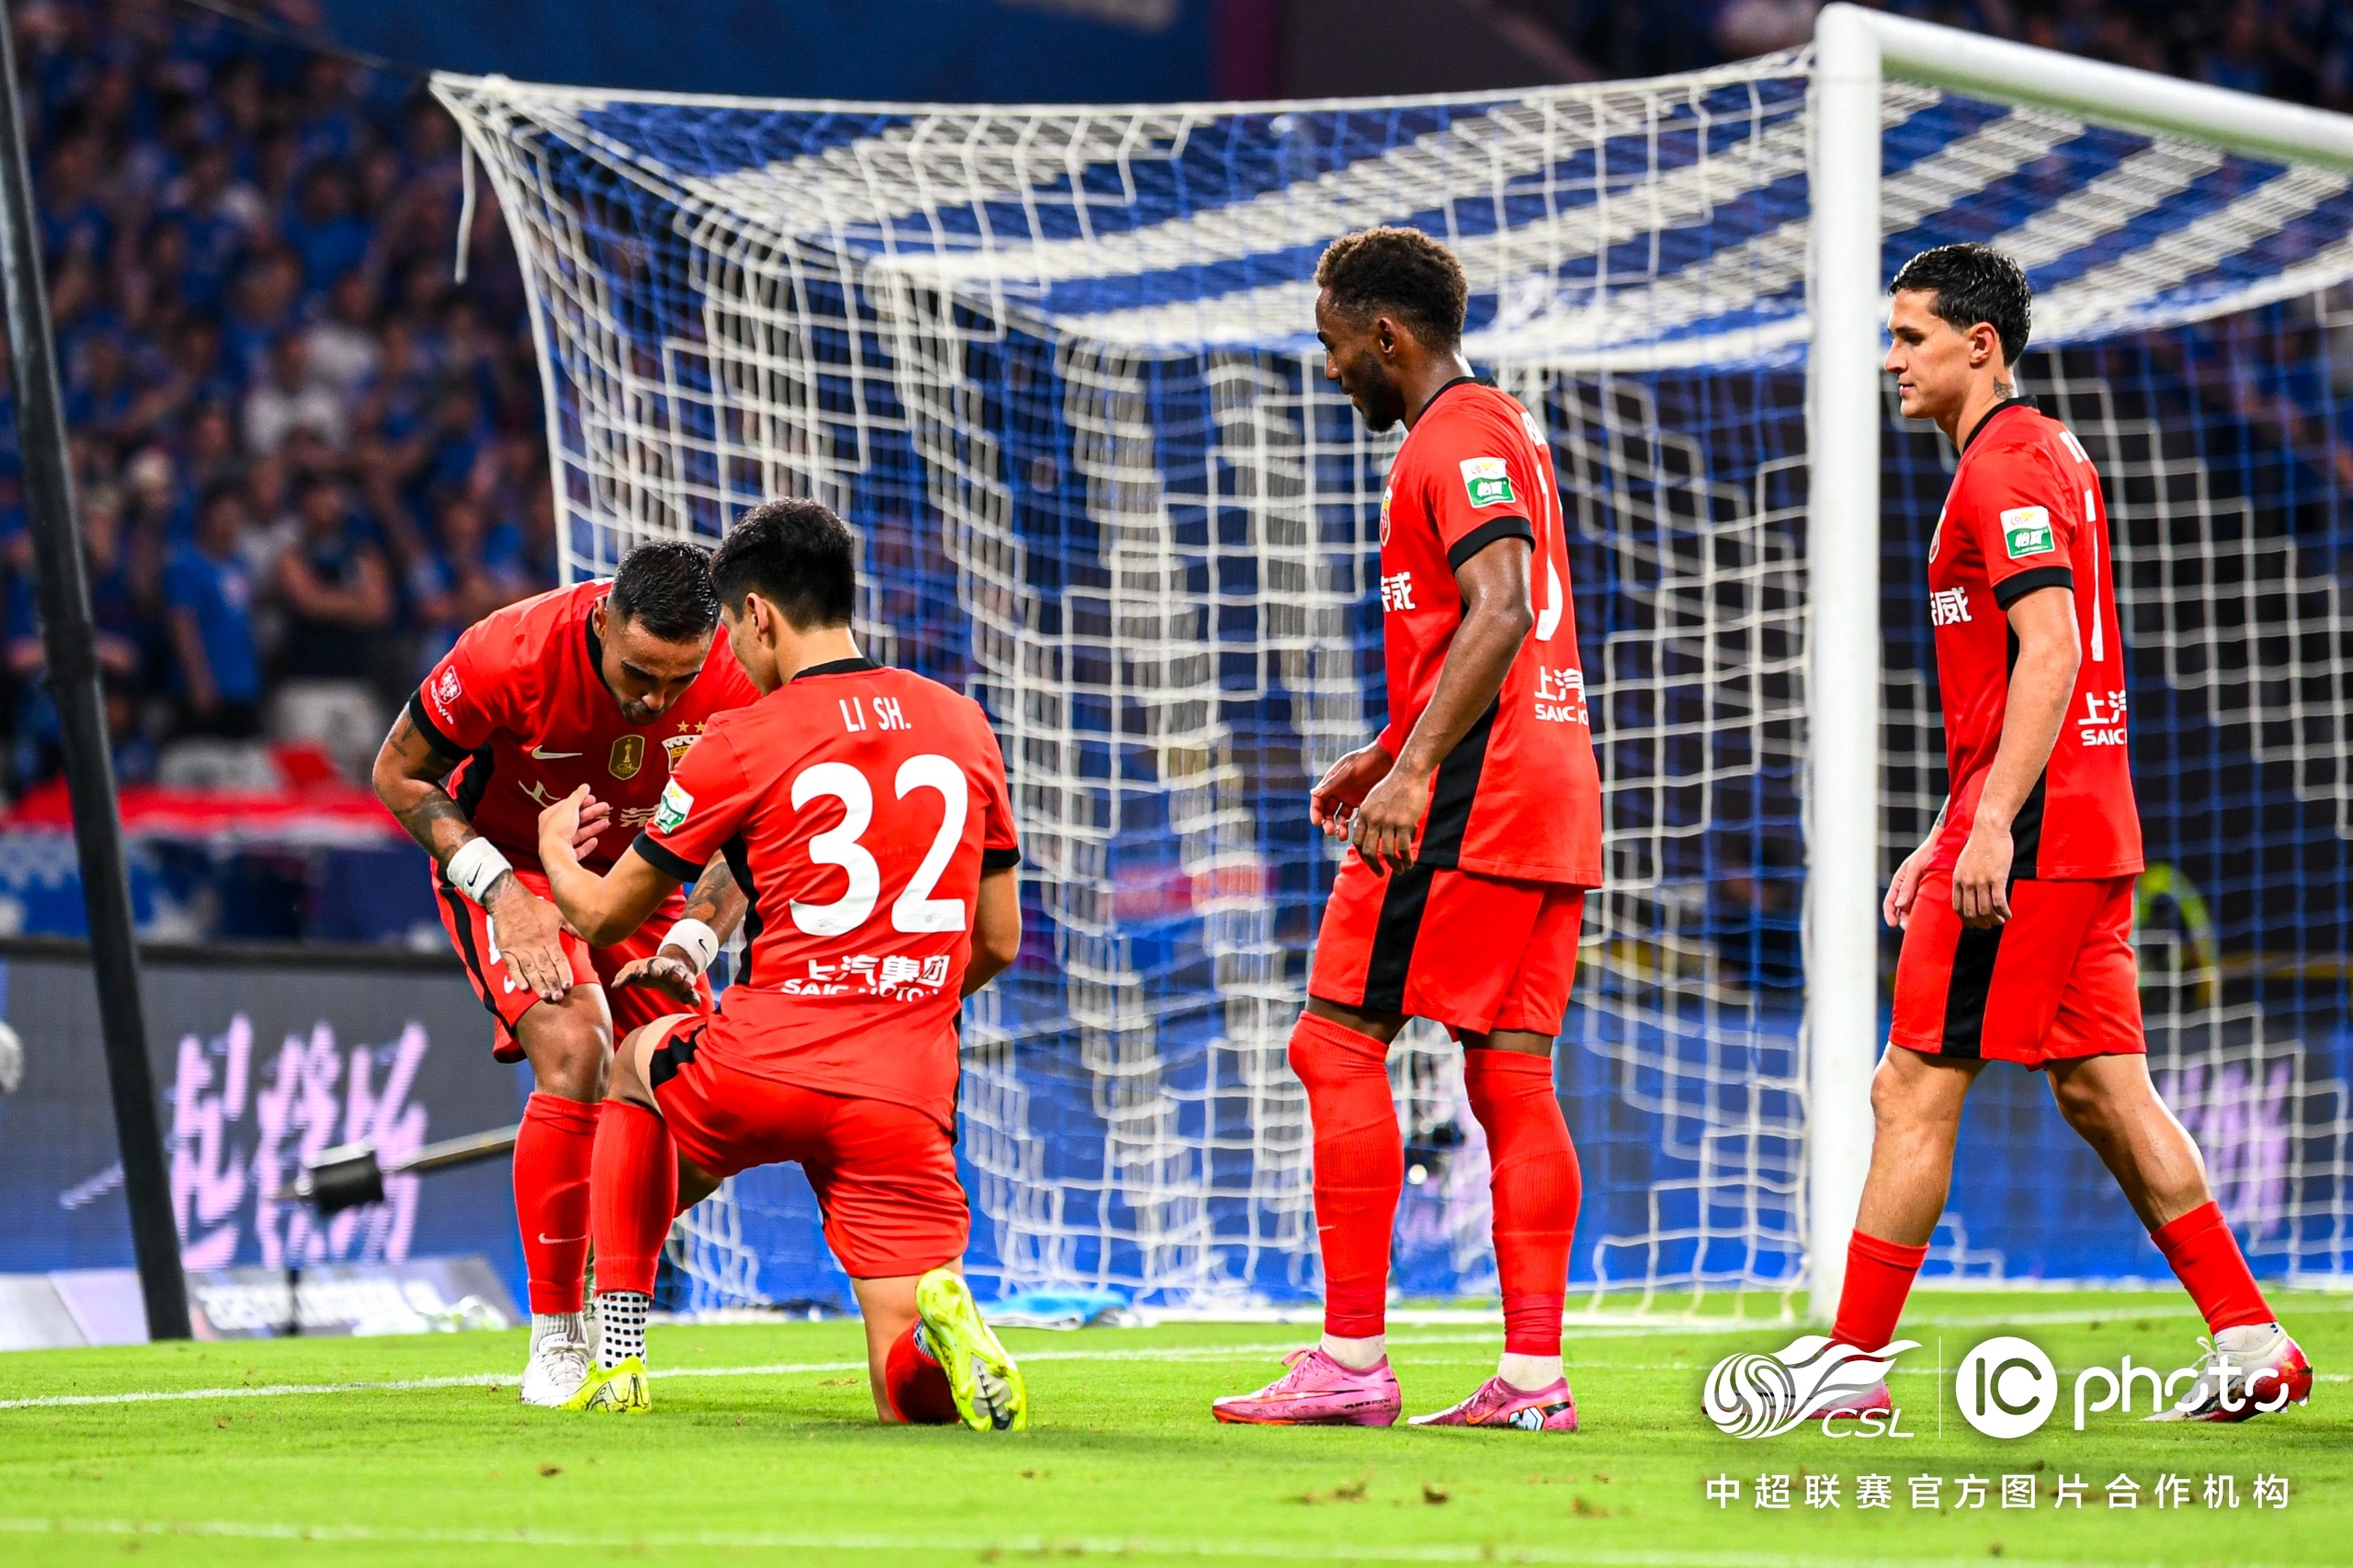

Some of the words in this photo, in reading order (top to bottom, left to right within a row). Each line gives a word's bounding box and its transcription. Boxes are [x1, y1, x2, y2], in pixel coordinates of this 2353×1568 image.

[838, 696, 867, 733] LI
[872, 696, 912, 731] SH.
[1534, 703, 1577, 723] SAIC
[2080, 728, 2125, 746] SAIC
[790, 754, 967, 937] 32
